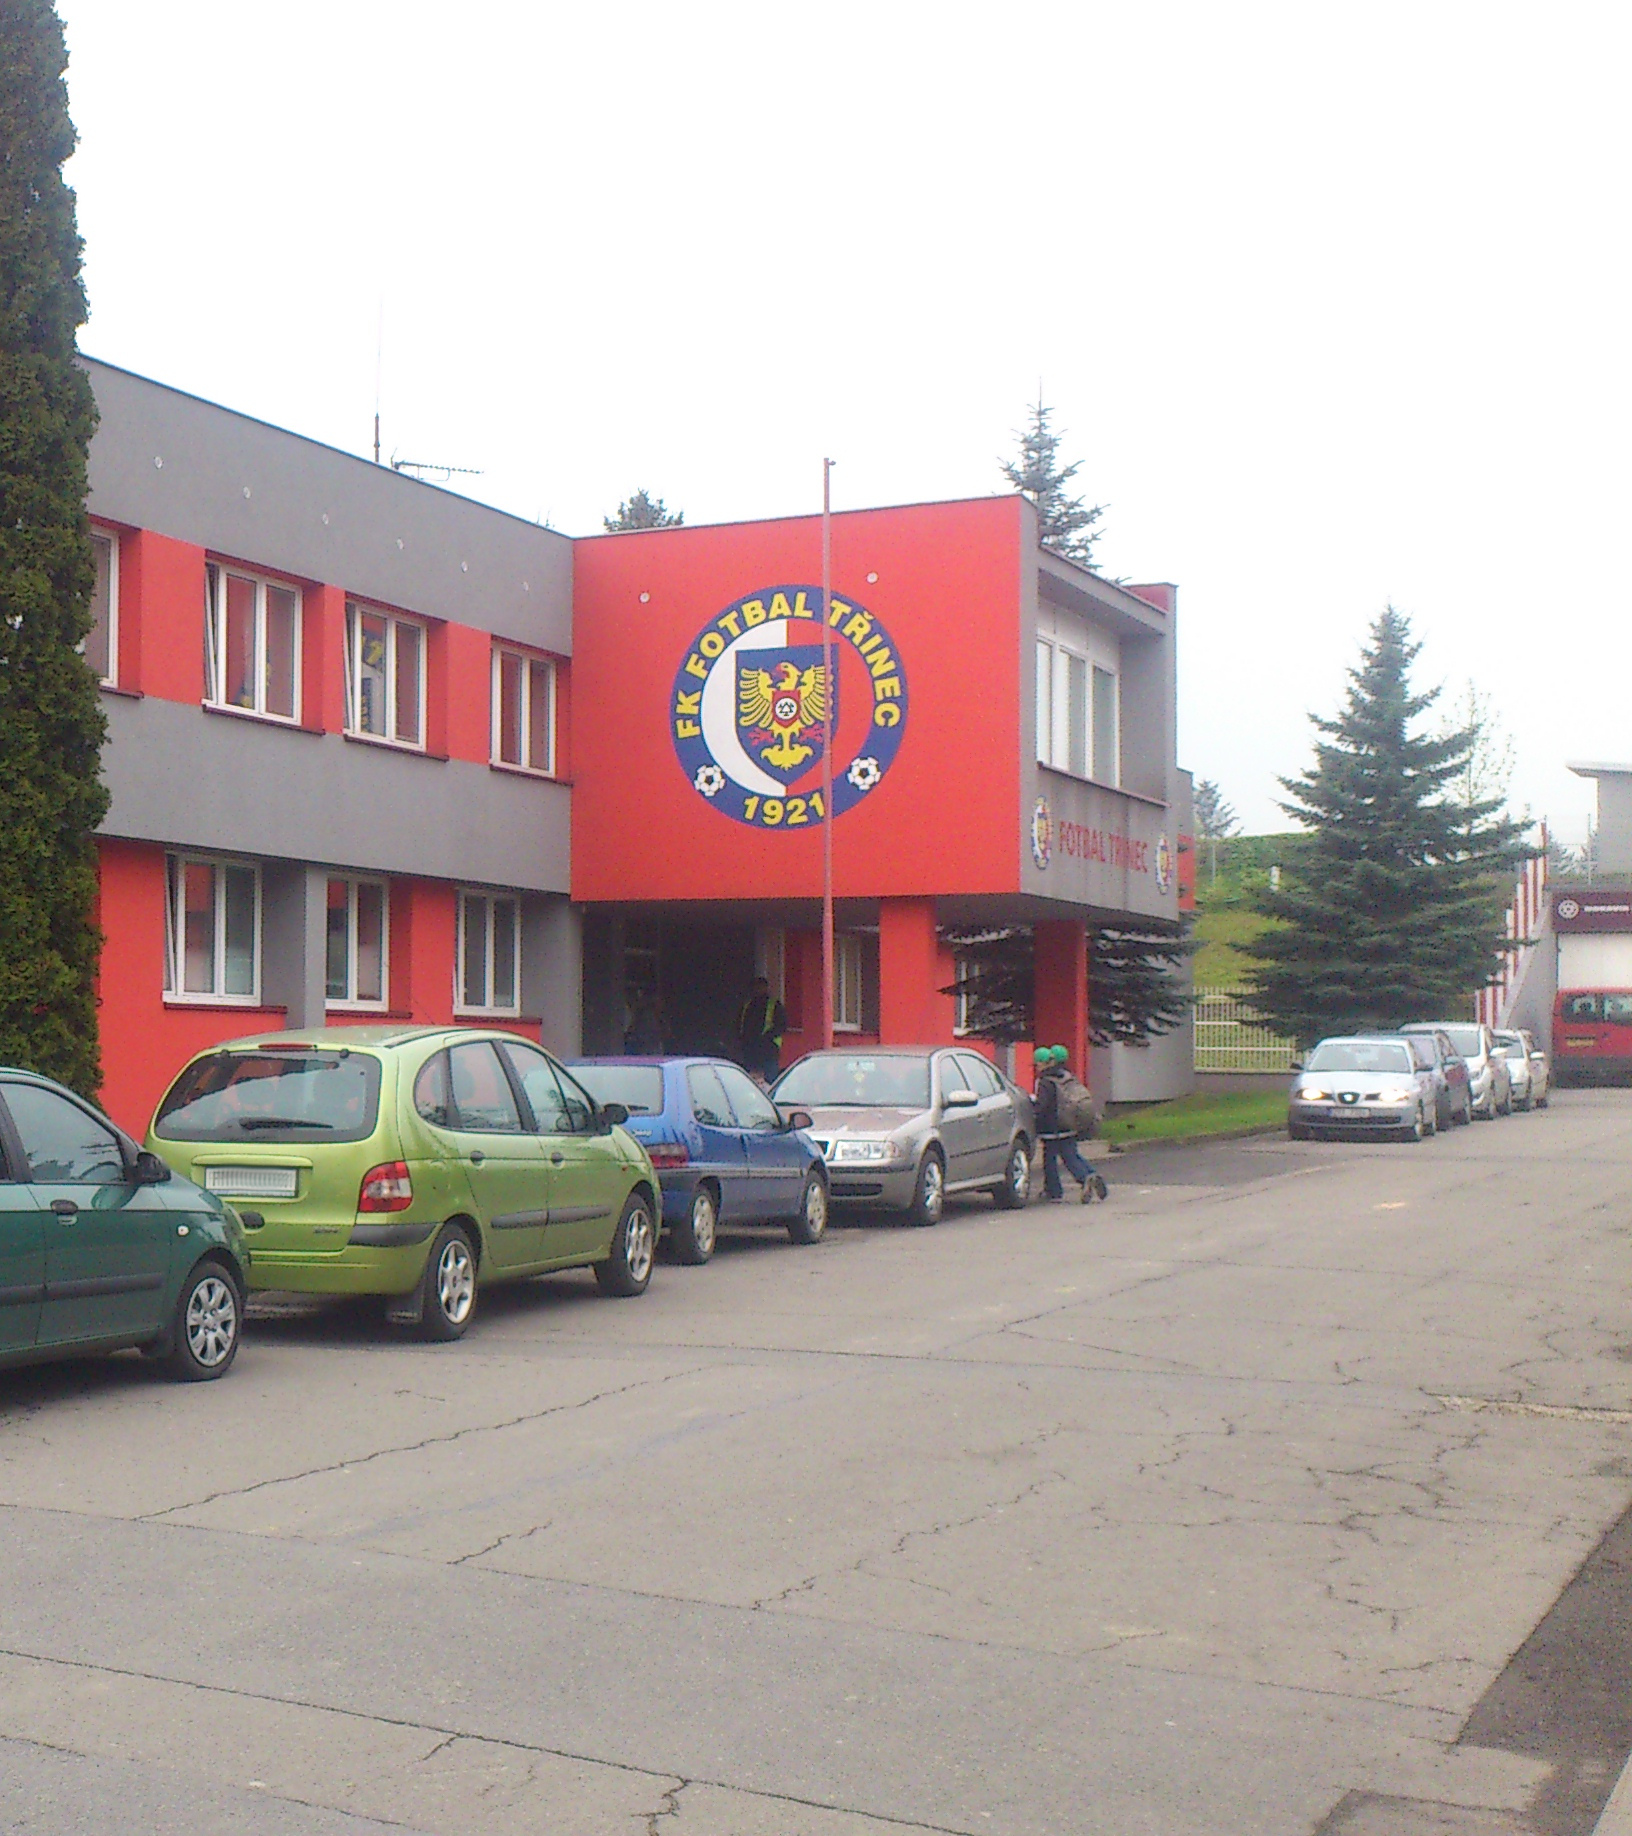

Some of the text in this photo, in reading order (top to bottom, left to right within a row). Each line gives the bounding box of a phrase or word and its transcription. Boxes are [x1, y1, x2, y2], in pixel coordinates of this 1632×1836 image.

[676, 592, 901, 739] FK FOTBAL TŘINEC
[744, 792, 825, 825] 1921
[1059, 820, 1106, 862] FOTBAL
